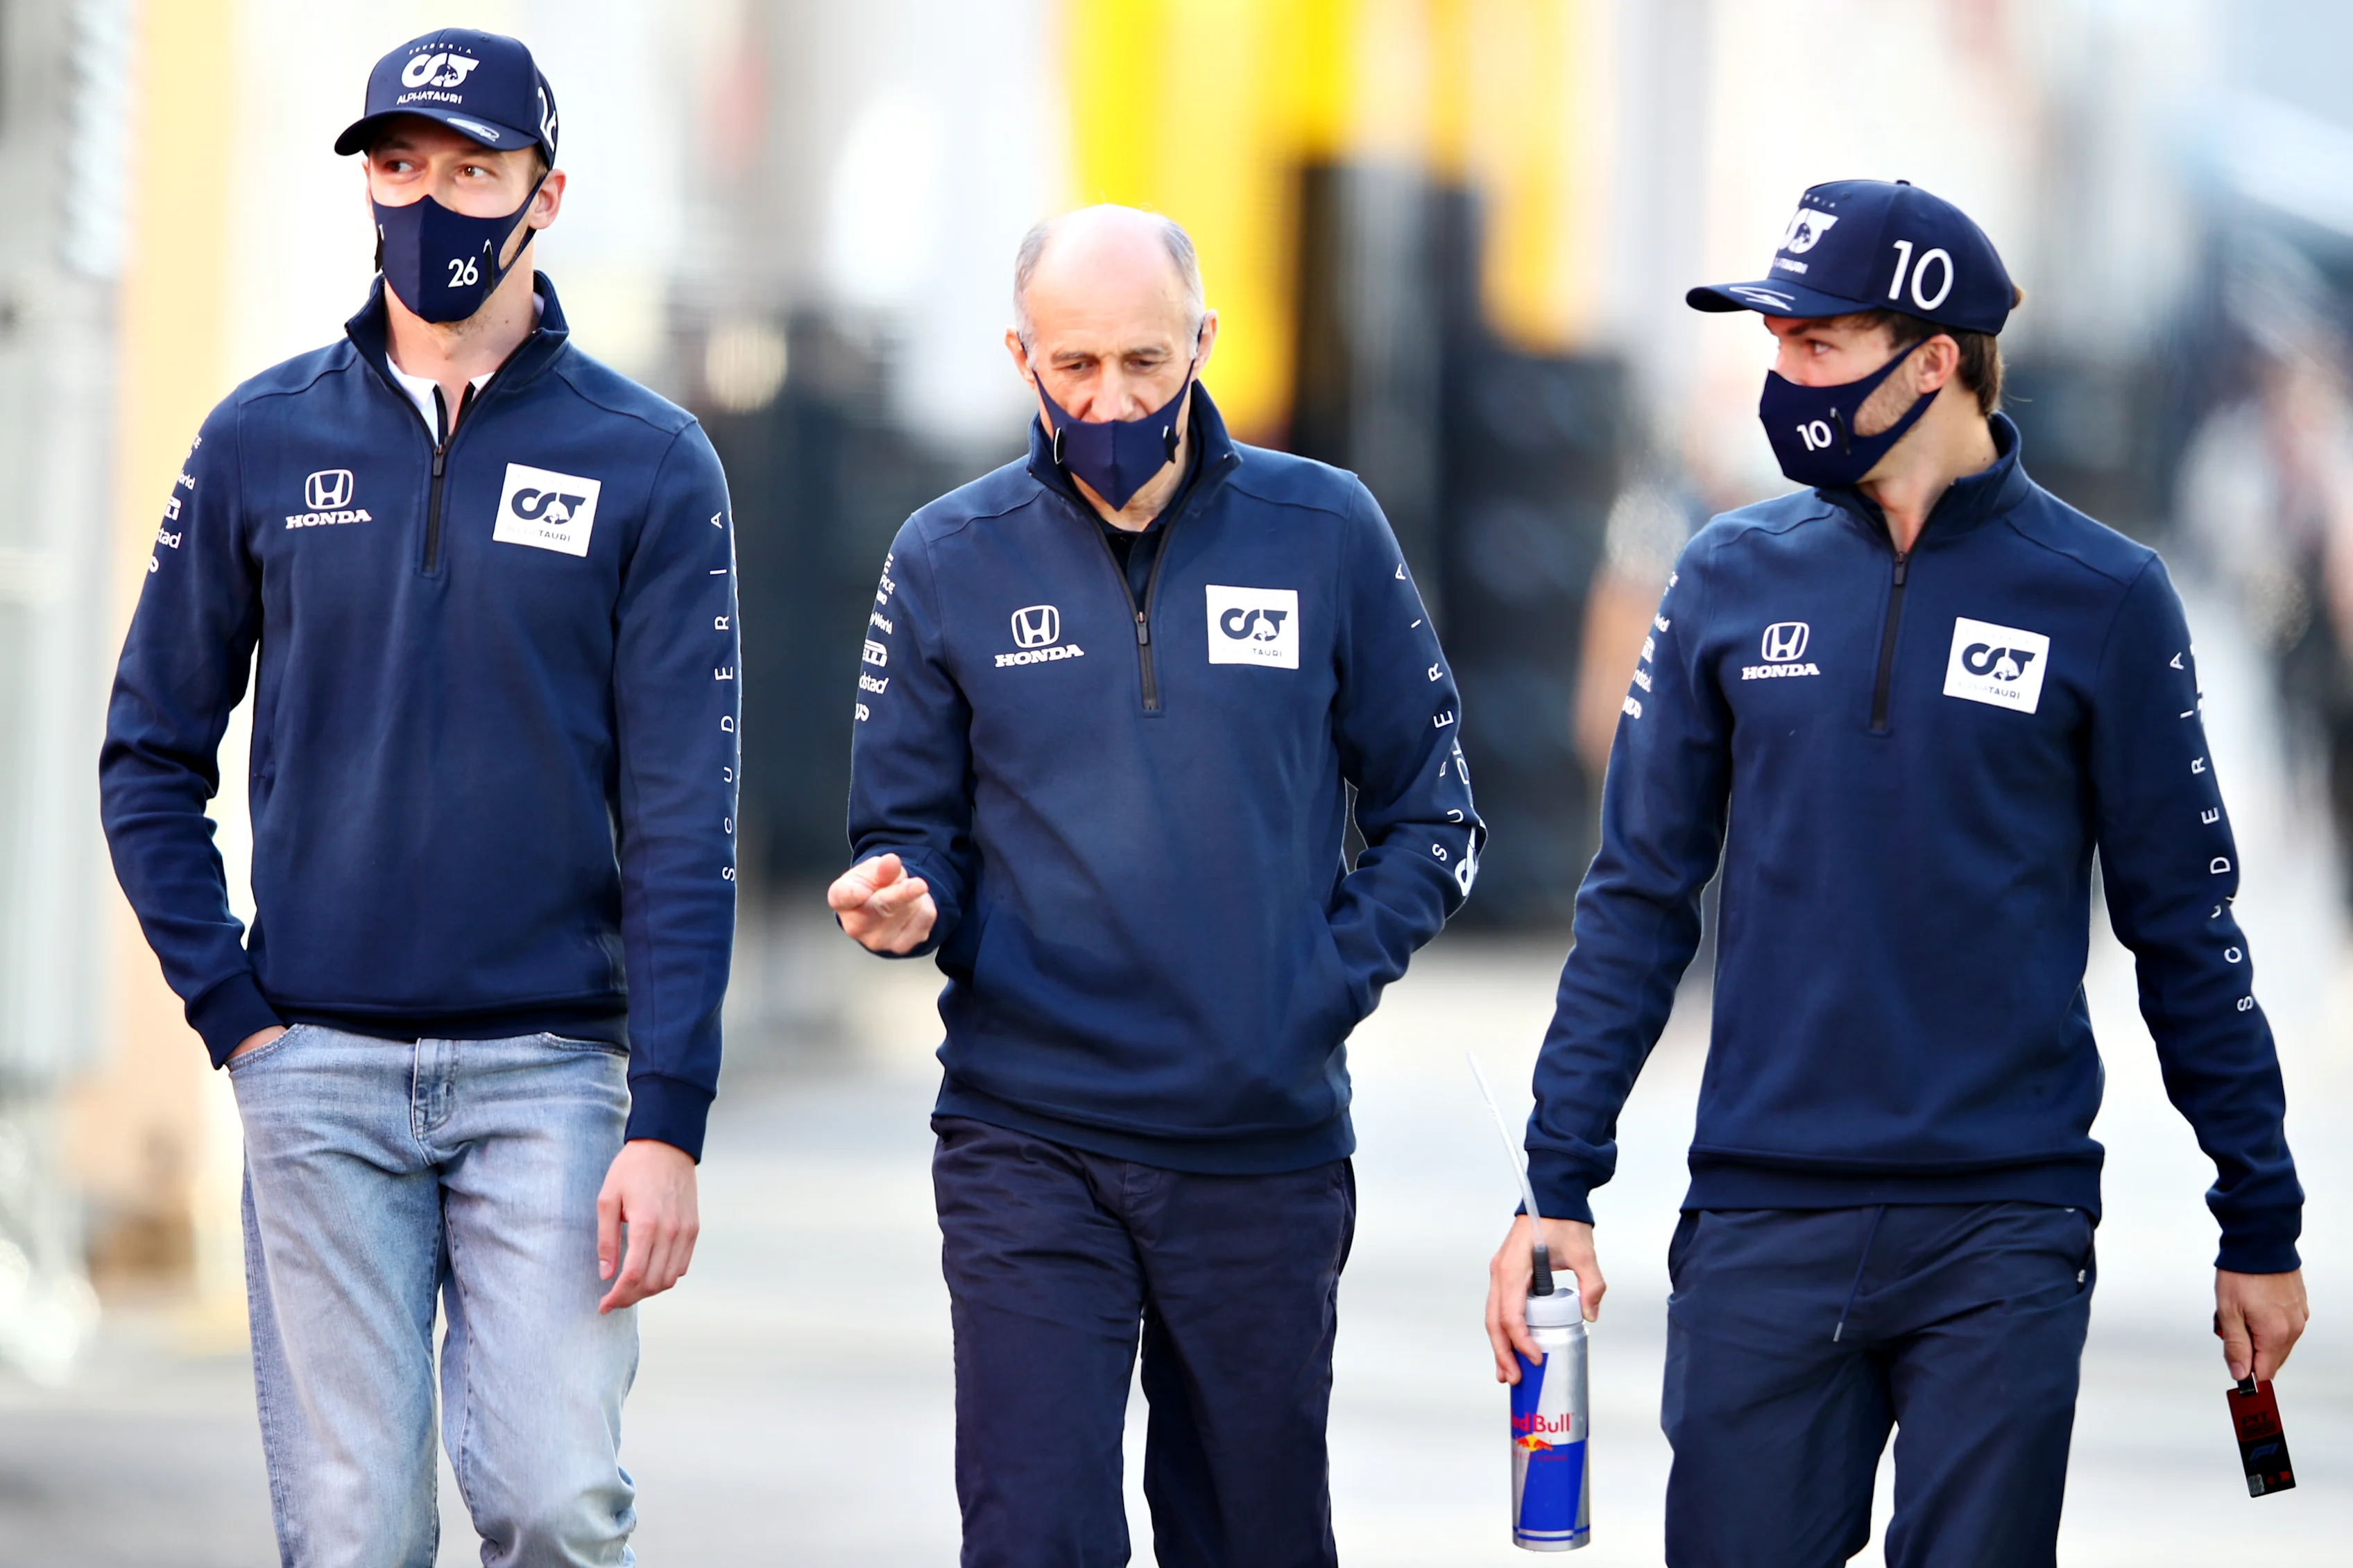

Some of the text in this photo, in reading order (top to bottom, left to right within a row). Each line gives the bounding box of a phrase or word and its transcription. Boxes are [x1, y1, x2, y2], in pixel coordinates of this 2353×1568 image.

[396, 91, 463, 105] ALPHATAURI
[447, 256, 479, 288] 26
[1888, 239, 1954, 311] 10
[1796, 420, 1832, 451] 10
[285, 509, 373, 529] HONDA
[869, 611, 893, 635] yWorld
[995, 644, 1085, 668] HONDA
[859, 671, 889, 694] dstad
[1741, 663, 1821, 680] HONDA
[710, 511, 735, 881] SCUDERIA
[1511, 1407, 1570, 1433] ed Bull
